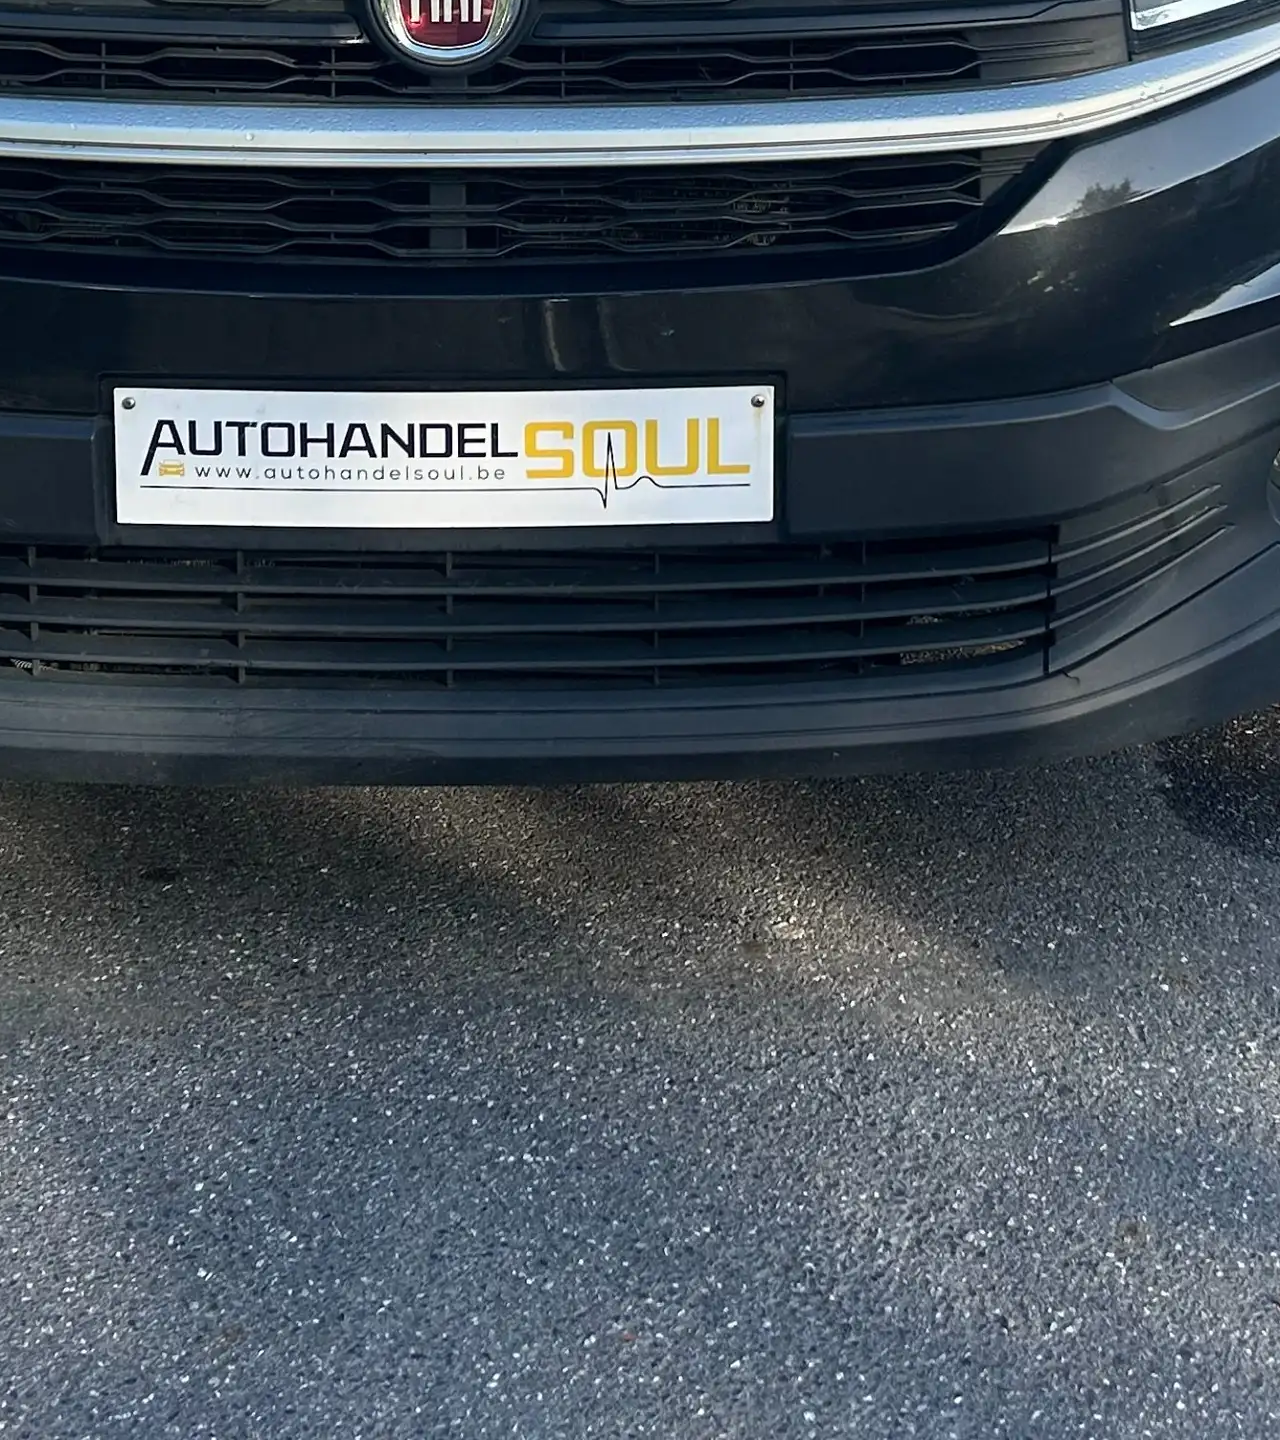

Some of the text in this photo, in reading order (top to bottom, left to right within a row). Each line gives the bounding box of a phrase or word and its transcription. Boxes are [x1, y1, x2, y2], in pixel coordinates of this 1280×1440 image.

[139, 417, 751, 479] AUTOHANDEL SOUL
[193, 464, 507, 482] www.autohandelsoul.be
